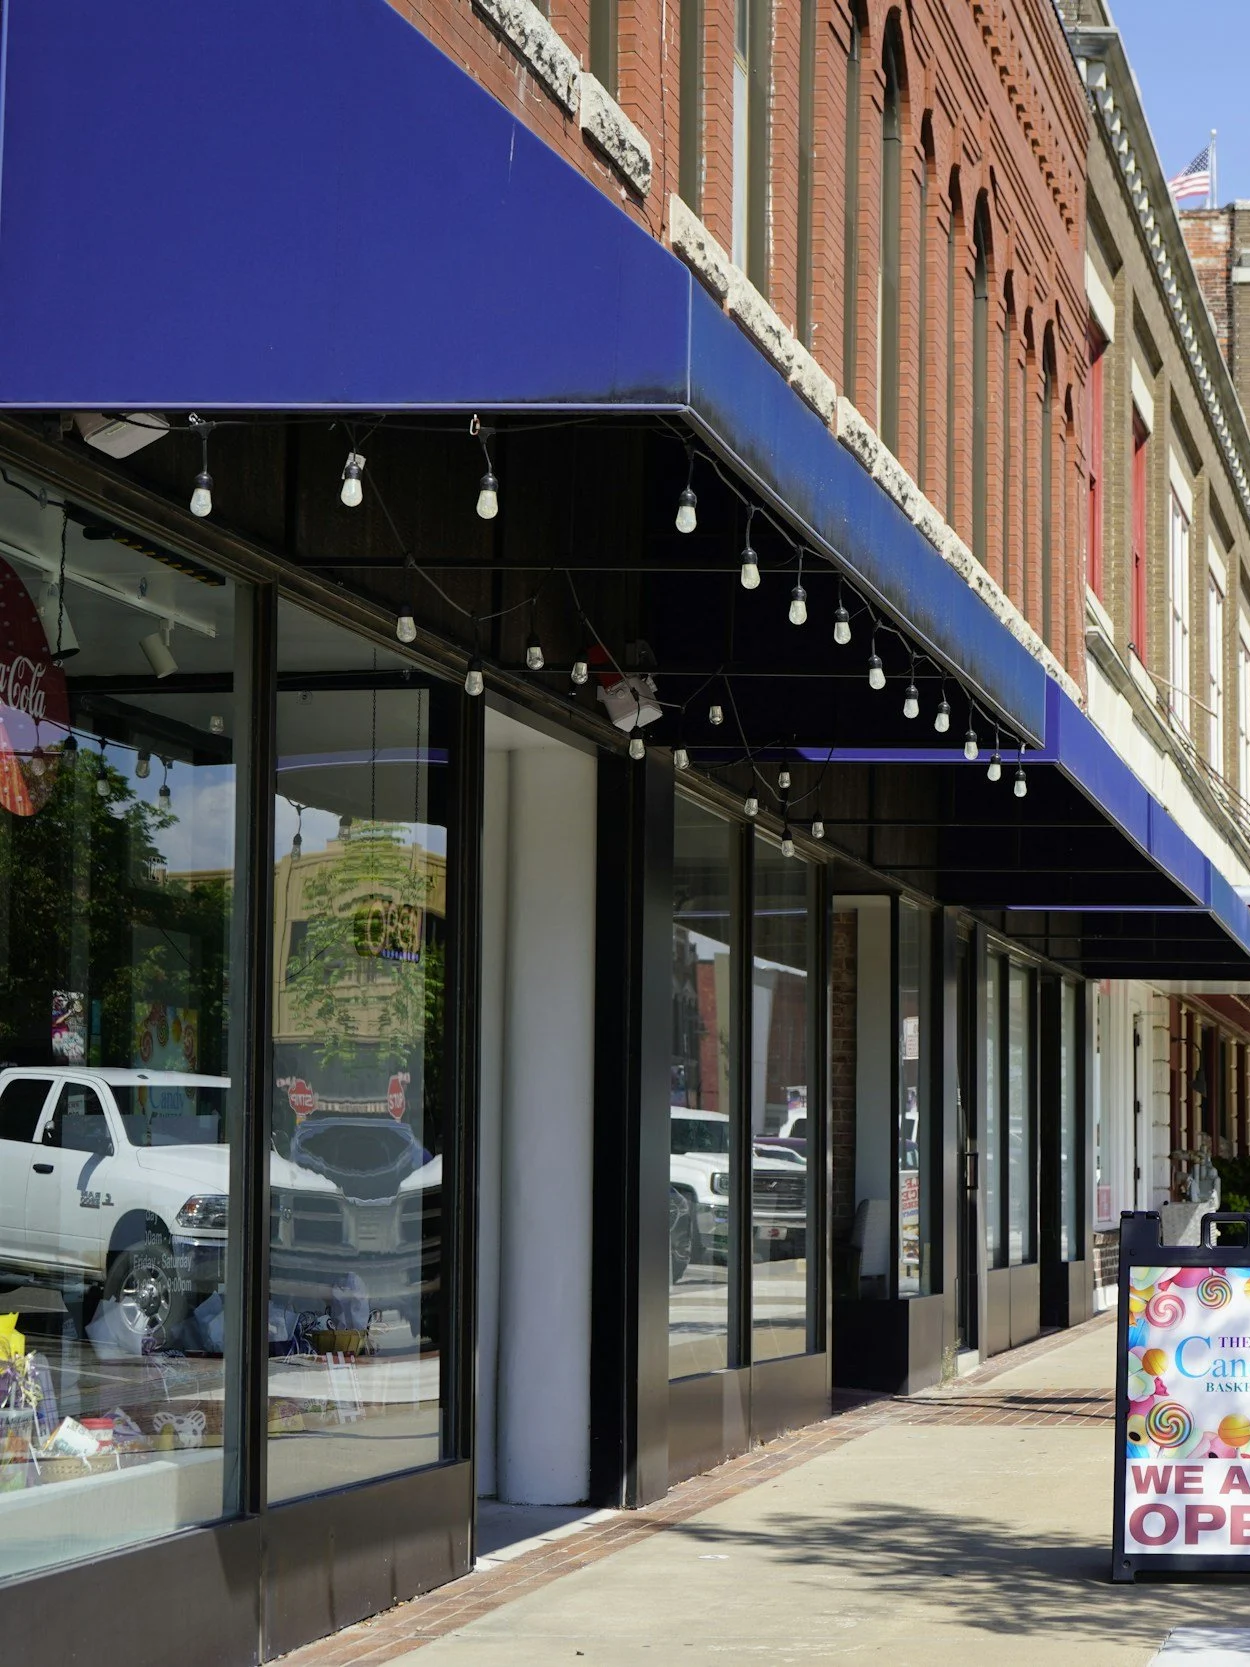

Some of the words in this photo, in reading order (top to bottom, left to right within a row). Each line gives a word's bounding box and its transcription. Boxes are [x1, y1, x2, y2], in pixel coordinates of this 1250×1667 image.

[133, 1254, 157, 1272] Friday
[161, 1253, 192, 1272] Saturday
[1131, 1465, 1204, 1495] WE
